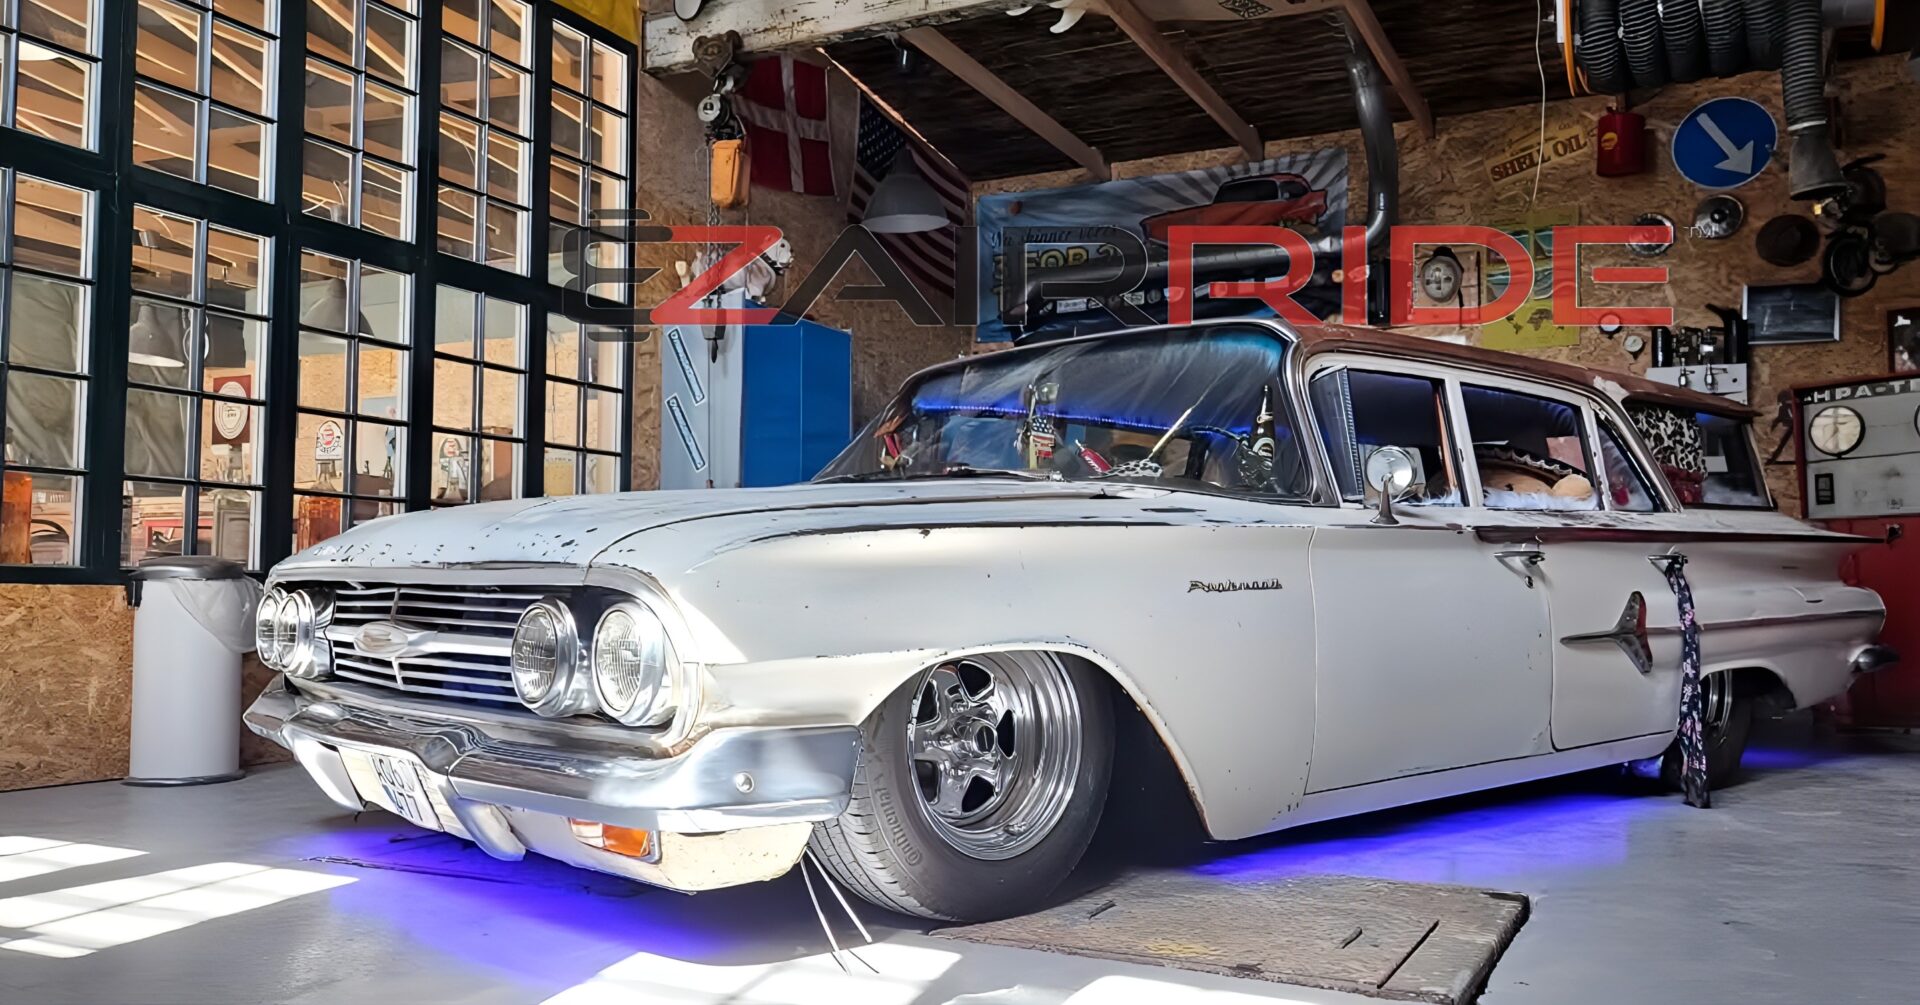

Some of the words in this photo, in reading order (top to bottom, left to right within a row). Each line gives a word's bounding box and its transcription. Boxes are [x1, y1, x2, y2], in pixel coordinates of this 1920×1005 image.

[1490, 147, 1551, 181] SHELL
[1553, 134, 1588, 157] OIL
[873, 786, 925, 868] Continental
